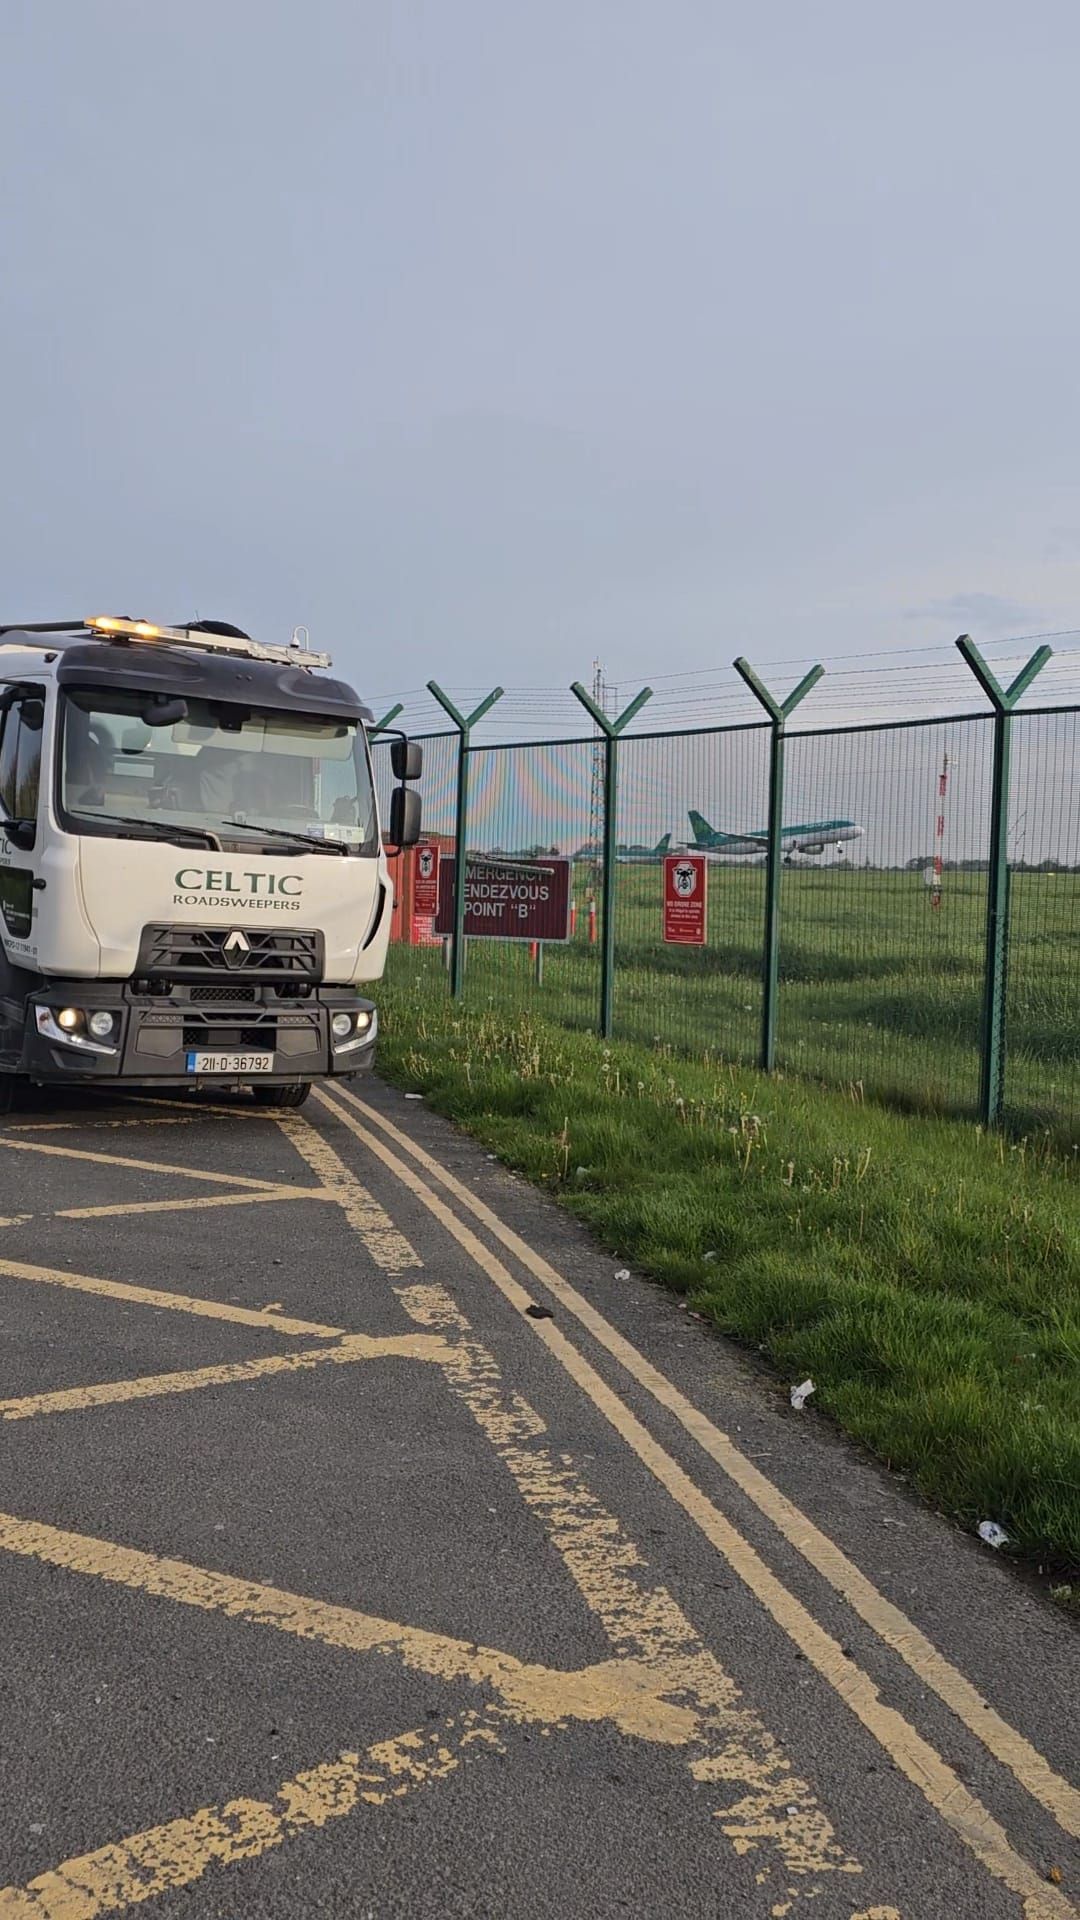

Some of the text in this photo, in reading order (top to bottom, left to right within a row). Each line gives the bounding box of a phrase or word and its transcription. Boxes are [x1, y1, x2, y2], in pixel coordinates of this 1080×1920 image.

[175, 868, 304, 896] CELTIC
[452, 884, 549, 900] ENDEZVOUS
[173, 894, 300, 911] ROADSWEEPERS
[463, 901, 506, 917] POINT
[202, 1056, 269, 1071] 211-D-36792
